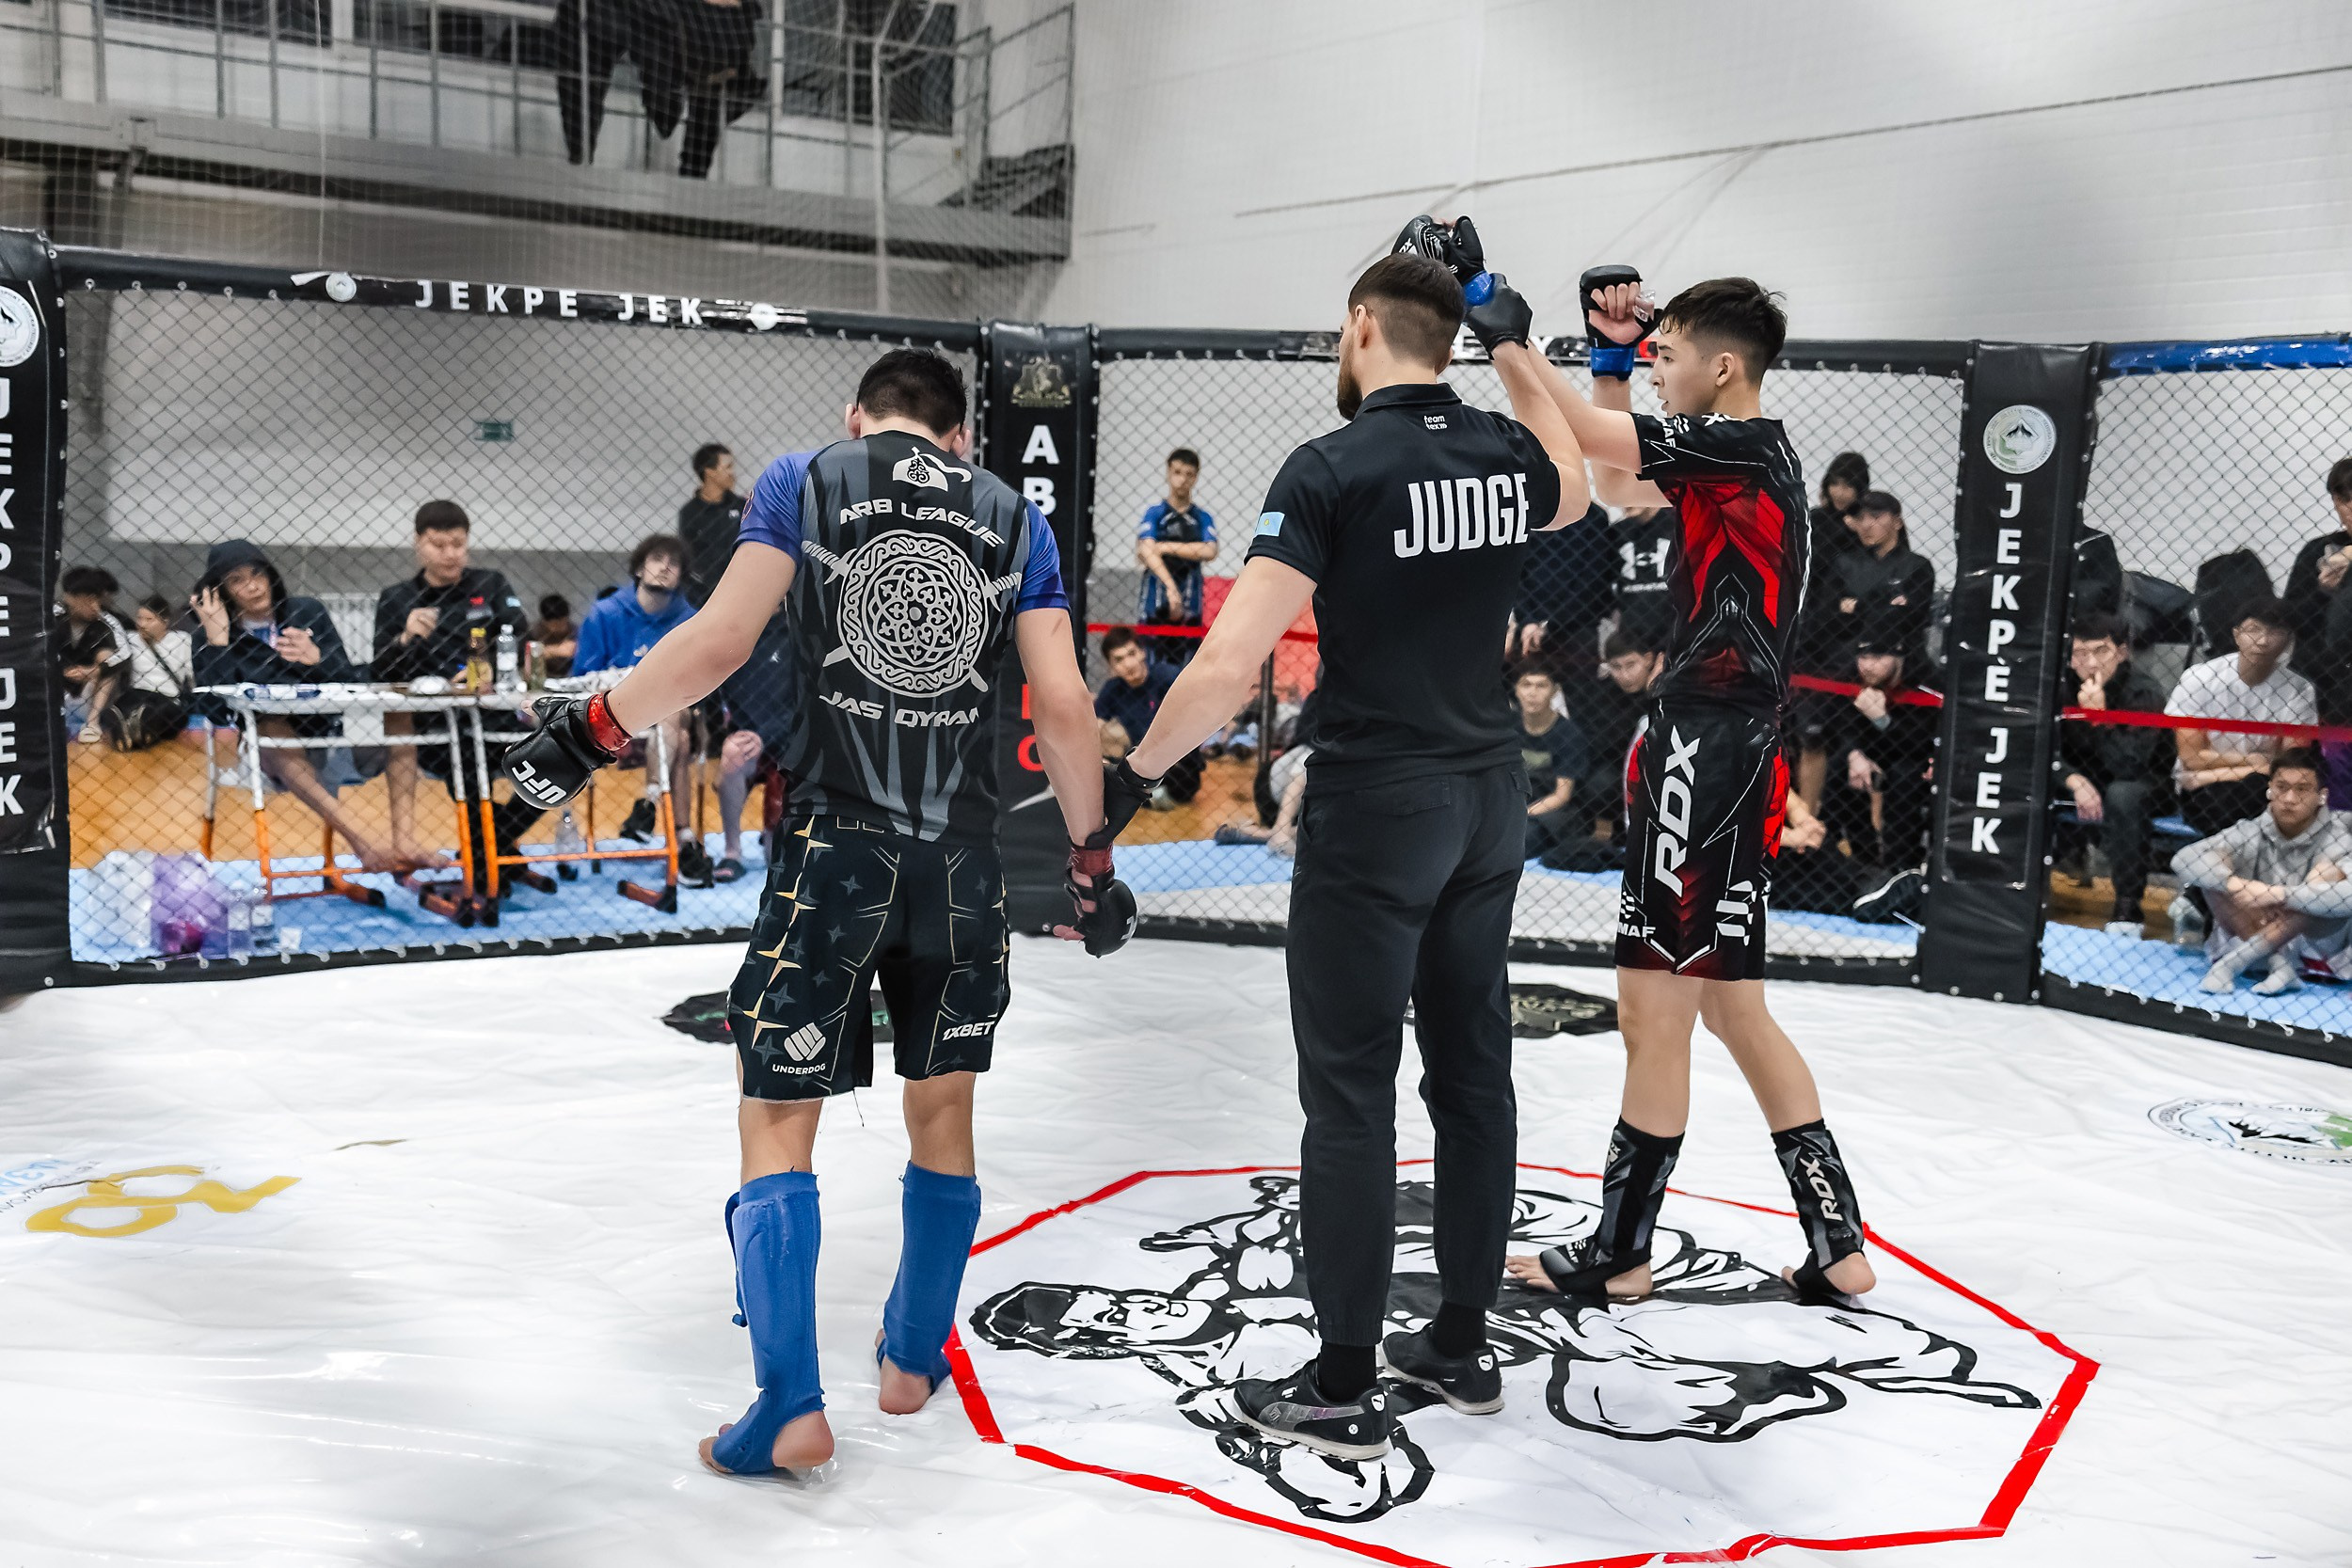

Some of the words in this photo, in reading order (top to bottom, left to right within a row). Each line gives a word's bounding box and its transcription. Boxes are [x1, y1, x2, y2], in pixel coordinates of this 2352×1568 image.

[415, 280, 579, 318] JEKPE
[617, 293, 704, 325] JEK
[1423, 415, 1445, 423] team
[840, 499, 893, 525] ARB
[901, 501, 1006, 547] LEAGUE
[1393, 472, 1529, 559] JUDGE
[1985, 483, 2024, 702] JEKPE
[818, 691, 884, 720] JAS
[511, 760, 567, 804] UFC
[1971, 727, 2010, 855] JEK
[1654, 724, 1701, 898] RDX
[771, 1063, 826, 1075] UNDERDOG
[1799, 1157, 1844, 1222] RDX
